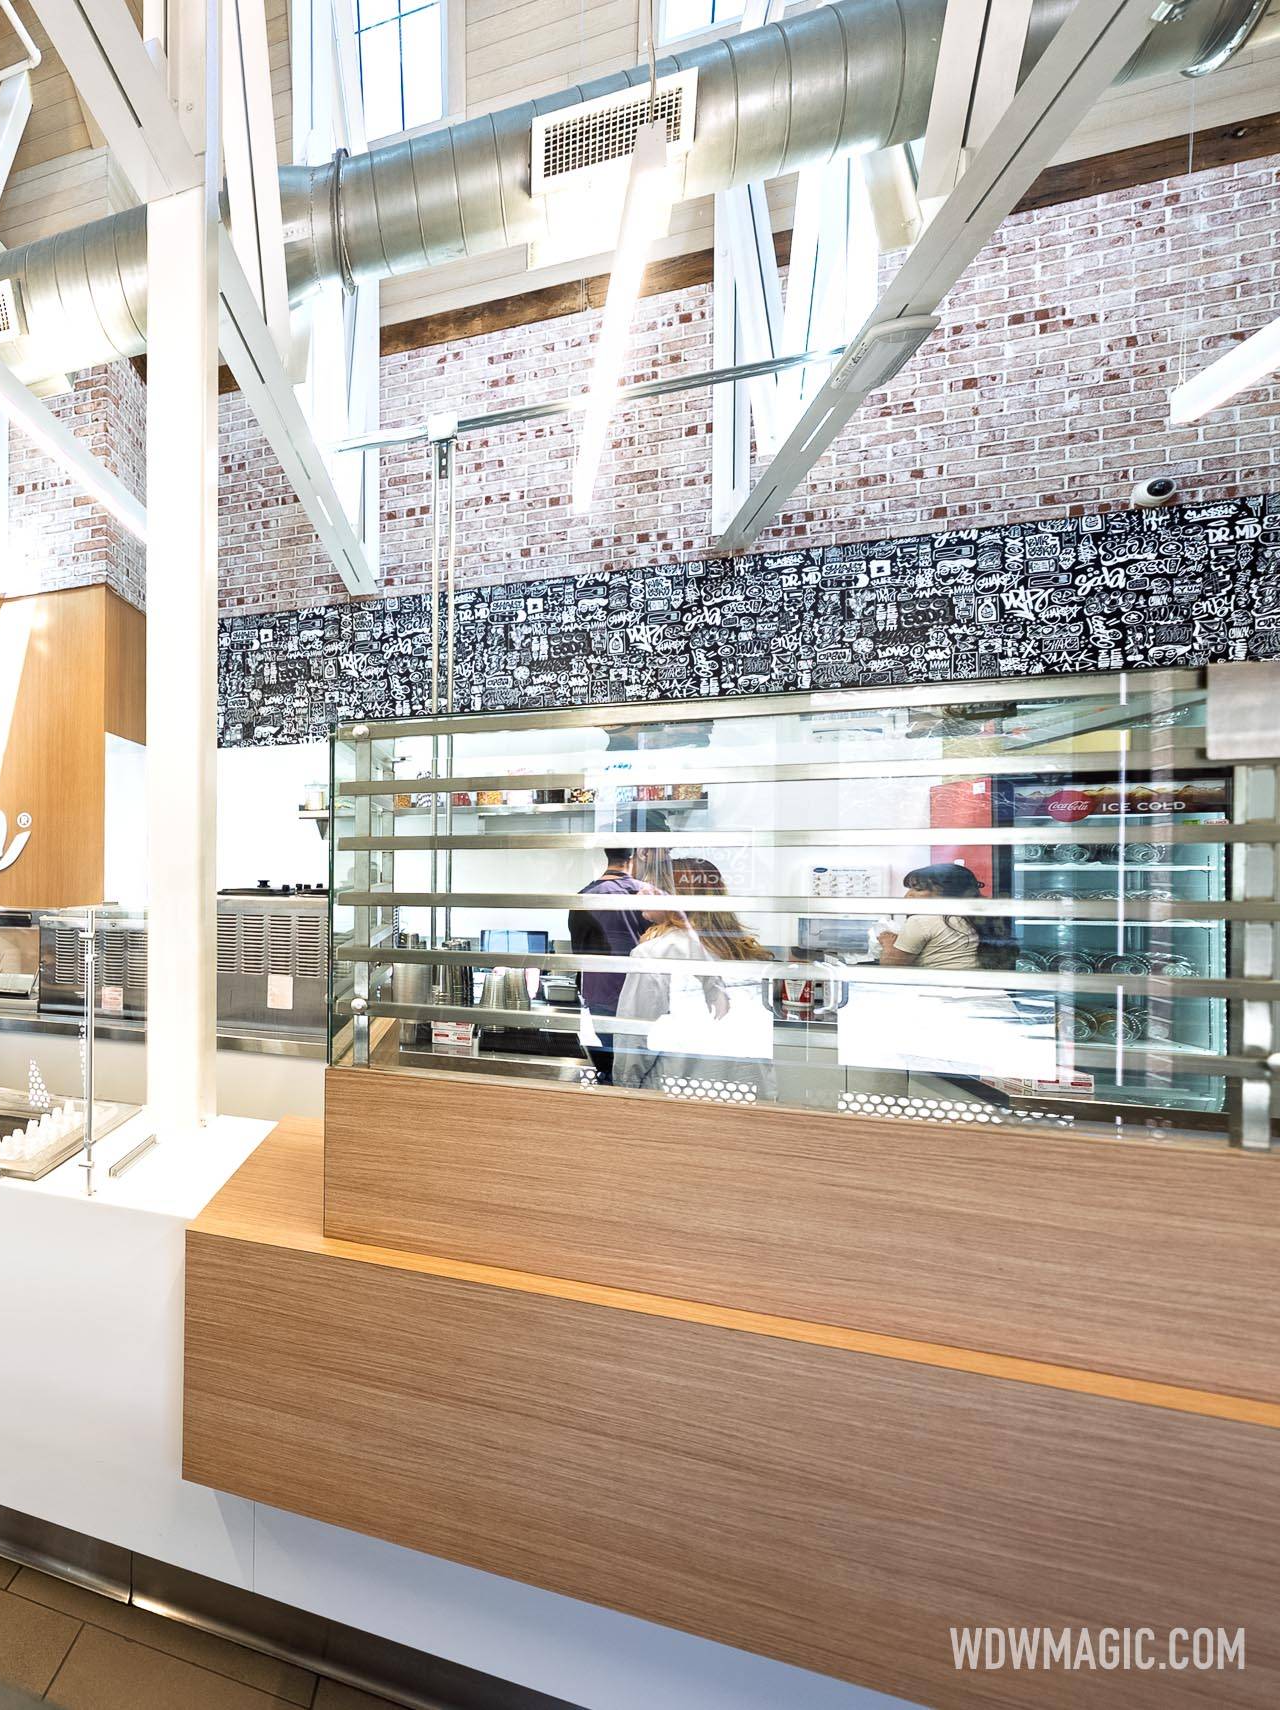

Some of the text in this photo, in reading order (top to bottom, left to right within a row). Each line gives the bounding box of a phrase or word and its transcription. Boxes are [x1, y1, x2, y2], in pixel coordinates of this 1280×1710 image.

[1236, 525, 1262, 539] MD
[802, 571, 821, 585] MD
[1102, 800, 1186, 812] ICE COLD
